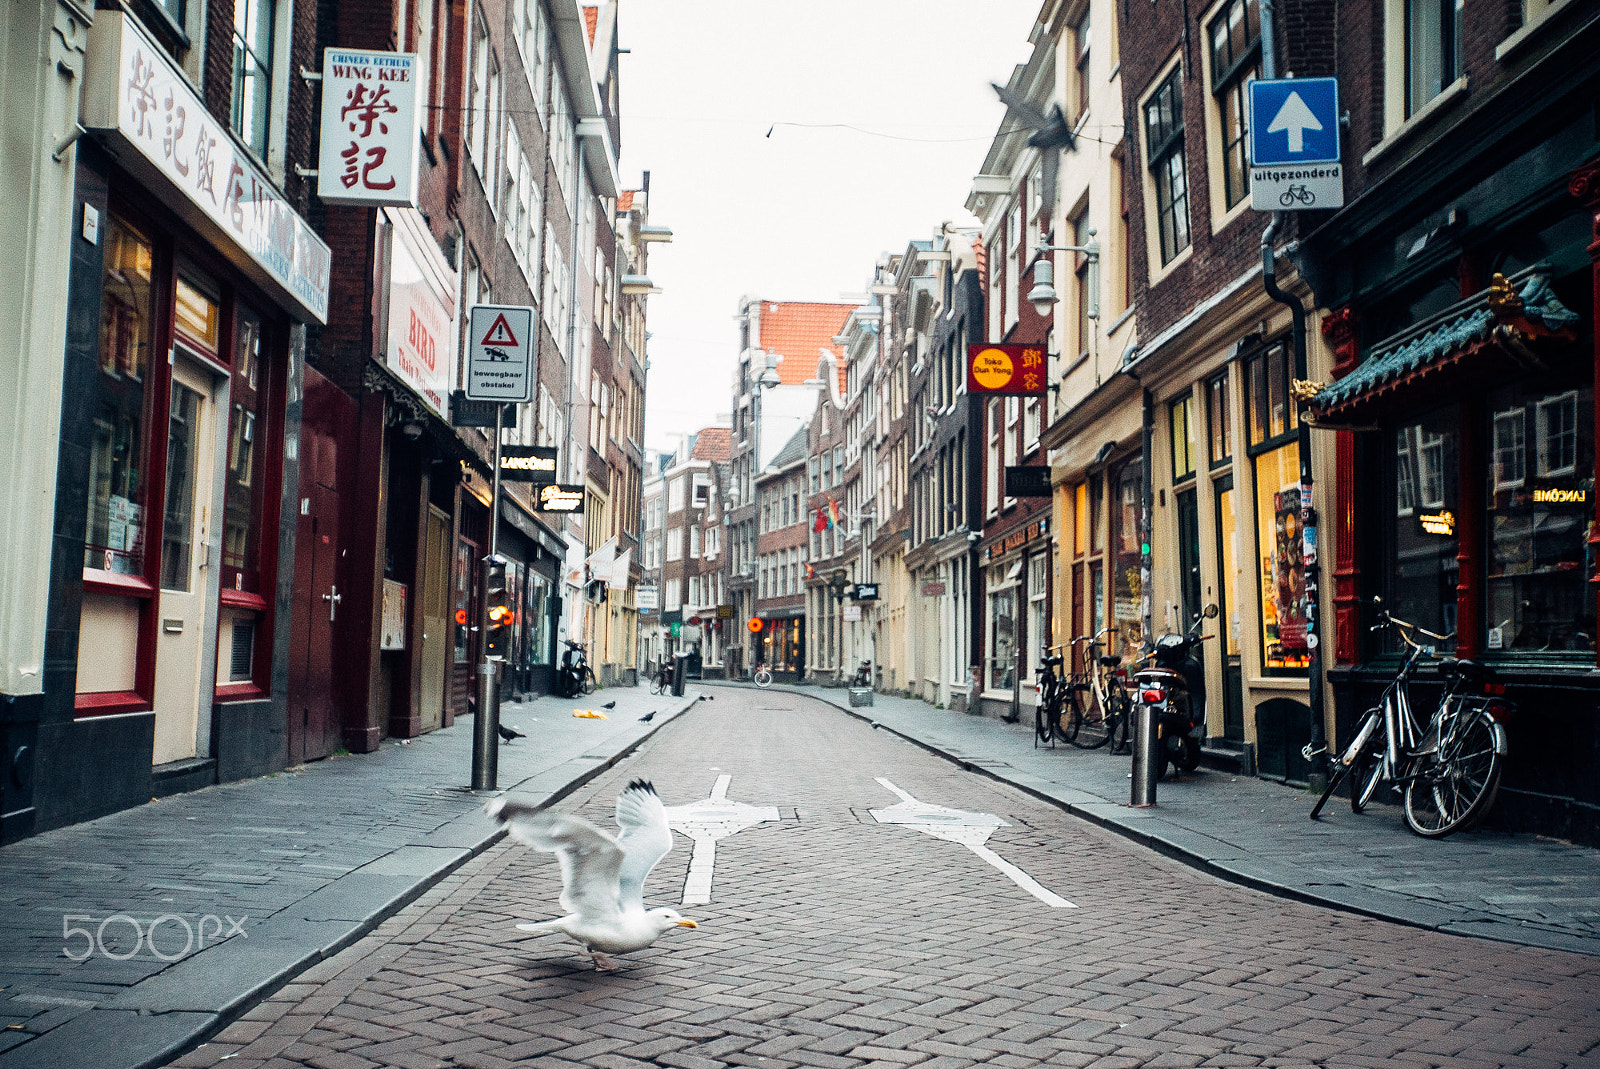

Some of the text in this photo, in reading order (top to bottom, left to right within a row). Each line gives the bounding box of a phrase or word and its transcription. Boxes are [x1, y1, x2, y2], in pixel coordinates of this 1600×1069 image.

[332, 54, 411, 67] CHINEES EETHUIS
[332, 64, 410, 82] WING KEE
[340, 82, 398, 191] 榮記
[1255, 166, 1339, 183] uitgezonderd
[409, 306, 435, 372] BIRD
[983, 357, 1003, 365] Toko
[473, 370, 523, 379] beweegbaar
[993, 366, 1012, 376] Yong
[500, 456, 556, 471] LANCÔME
